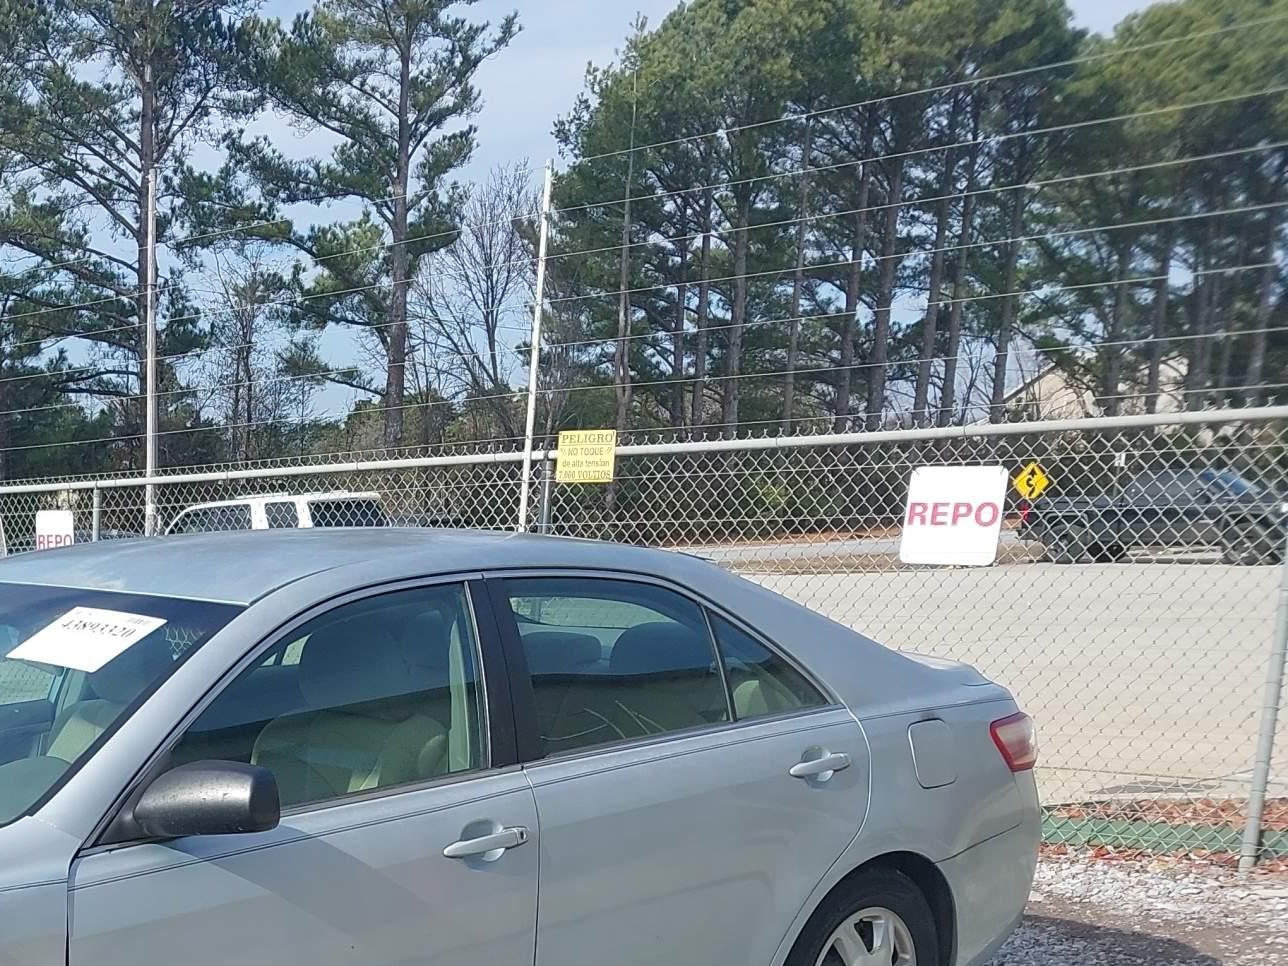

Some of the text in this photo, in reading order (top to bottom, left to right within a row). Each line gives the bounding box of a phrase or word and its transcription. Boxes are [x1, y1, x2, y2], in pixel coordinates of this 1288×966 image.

[562, 433, 613, 443] PELIGRO
[568, 447, 604, 456] NO TOQUE
[907, 502, 1000, 527] REPO
